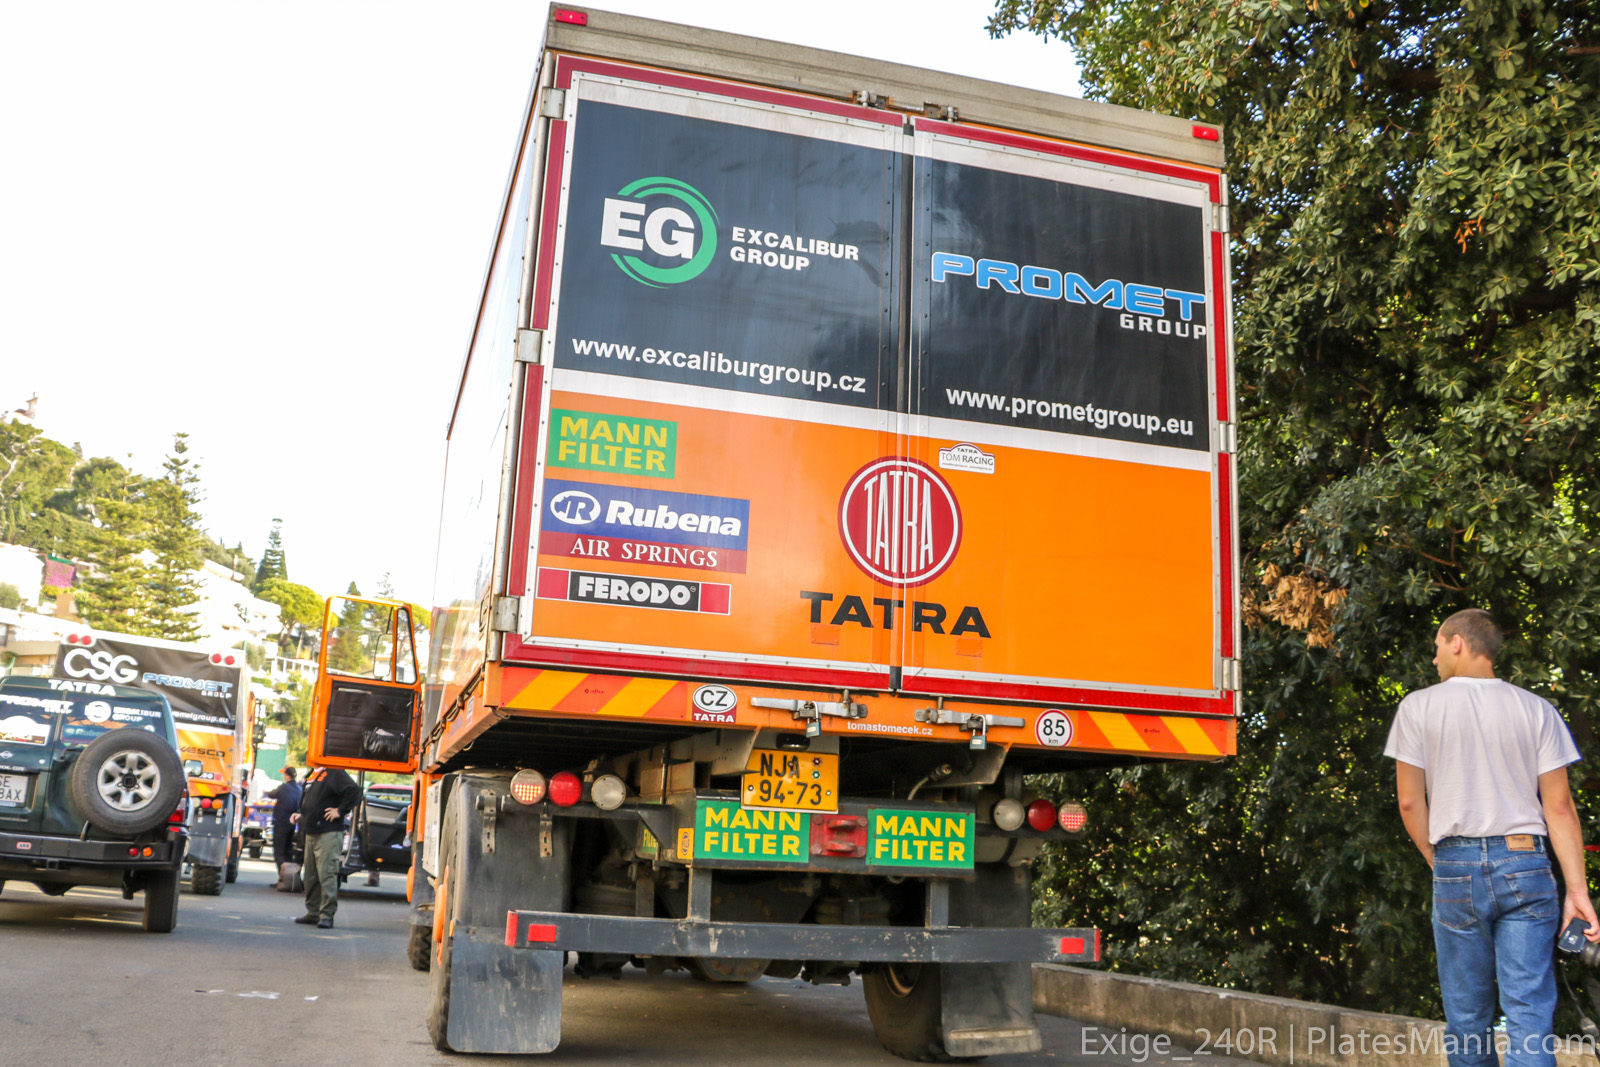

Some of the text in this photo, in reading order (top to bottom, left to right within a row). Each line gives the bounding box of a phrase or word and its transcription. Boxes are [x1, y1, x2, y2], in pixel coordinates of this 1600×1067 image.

[600, 197, 695, 260] EG
[732, 226, 860, 261] EXCALIBUR
[730, 246, 810, 271] GROUP
[931, 251, 1206, 321] PROMET
[1119, 313, 1207, 339] GROUP
[571, 338, 866, 393] www.excaliburgroup.cz
[946, 388, 1194, 436] www.prometgroup.eu
[560, 416, 667, 448] MANN
[558, 440, 666, 472] FILTER
[941, 452, 961, 462] TOM
[962, 455, 994, 466] RACING
[605, 499, 742, 537] Rubena
[863, 470, 934, 574] TATRA
[570, 537, 718, 568] AIR SPRINGS
[578, 576, 691, 606] FERODO
[800, 590, 992, 639] TATRA
[63, 648, 139, 684] CSG
[48, 679, 116, 696] TATRA
[142, 672, 233, 693] PROMET
[700, 690, 728, 707] CZ
[694, 712, 735, 723] TATRA
[847, 721, 933, 735] tomastomecek.cz
[1043, 718, 1065, 737] 85
[760, 753, 800, 779] NJA
[759, 779, 822, 806] 94-73
[705, 807, 801, 831] MANN
[875, 814, 966, 838] MANN
[704, 831, 800, 856] FILTER
[875, 838, 965, 862] FILTER
